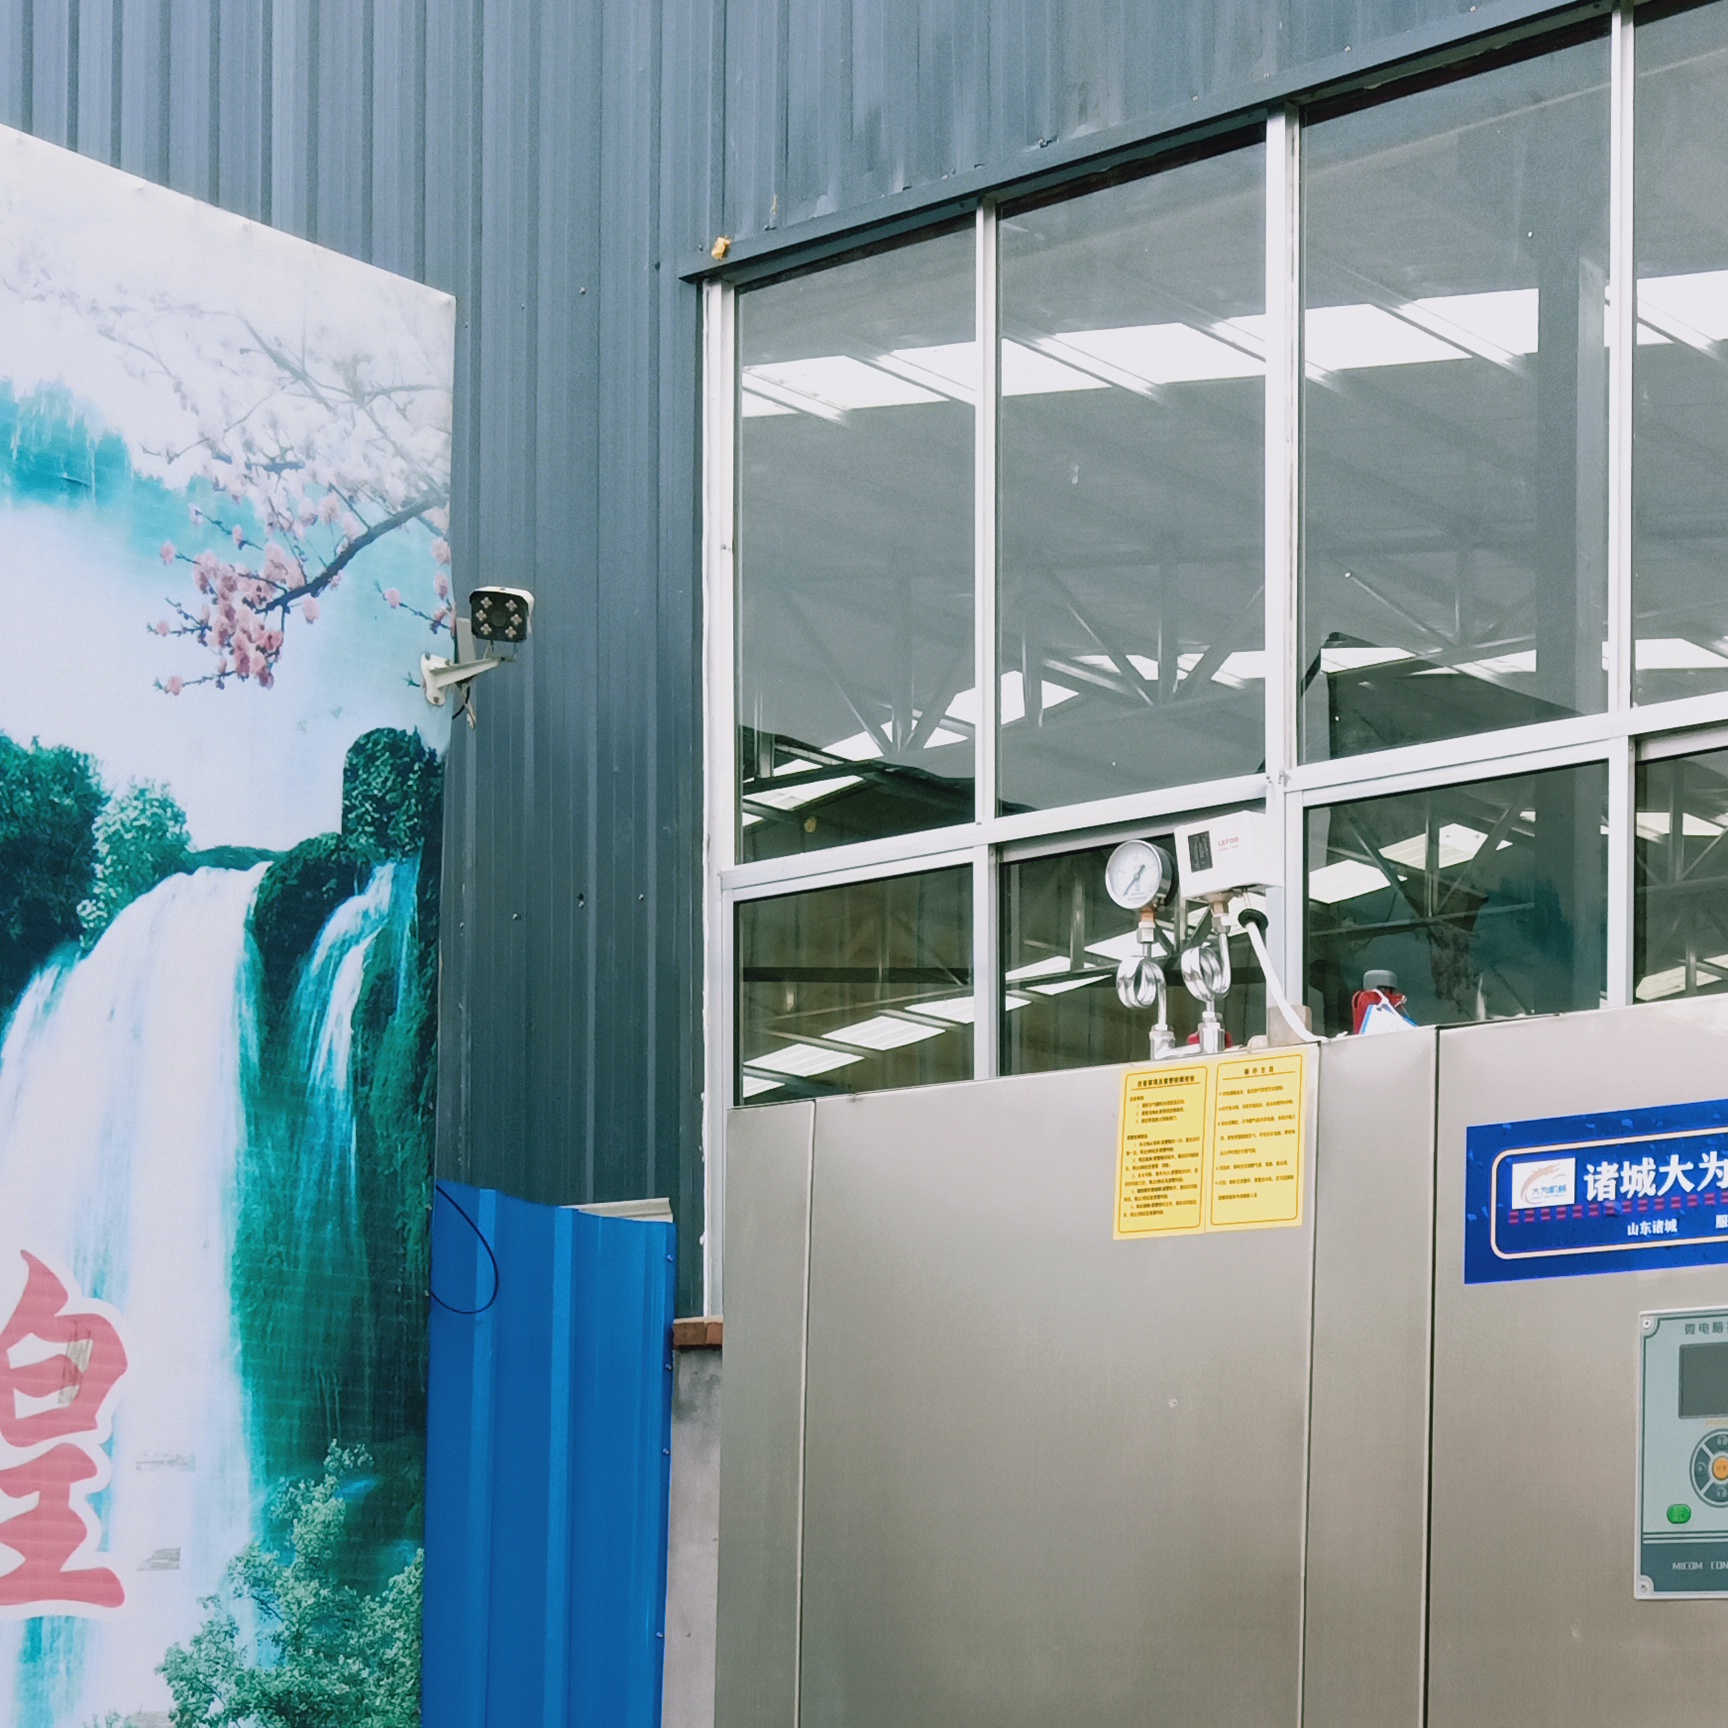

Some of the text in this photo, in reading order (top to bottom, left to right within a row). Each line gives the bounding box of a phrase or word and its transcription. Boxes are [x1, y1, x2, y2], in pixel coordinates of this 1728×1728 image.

[1627, 1218, 1678, 1236] 山东诸城
[1672, 1560, 1703, 1571] MICOM
